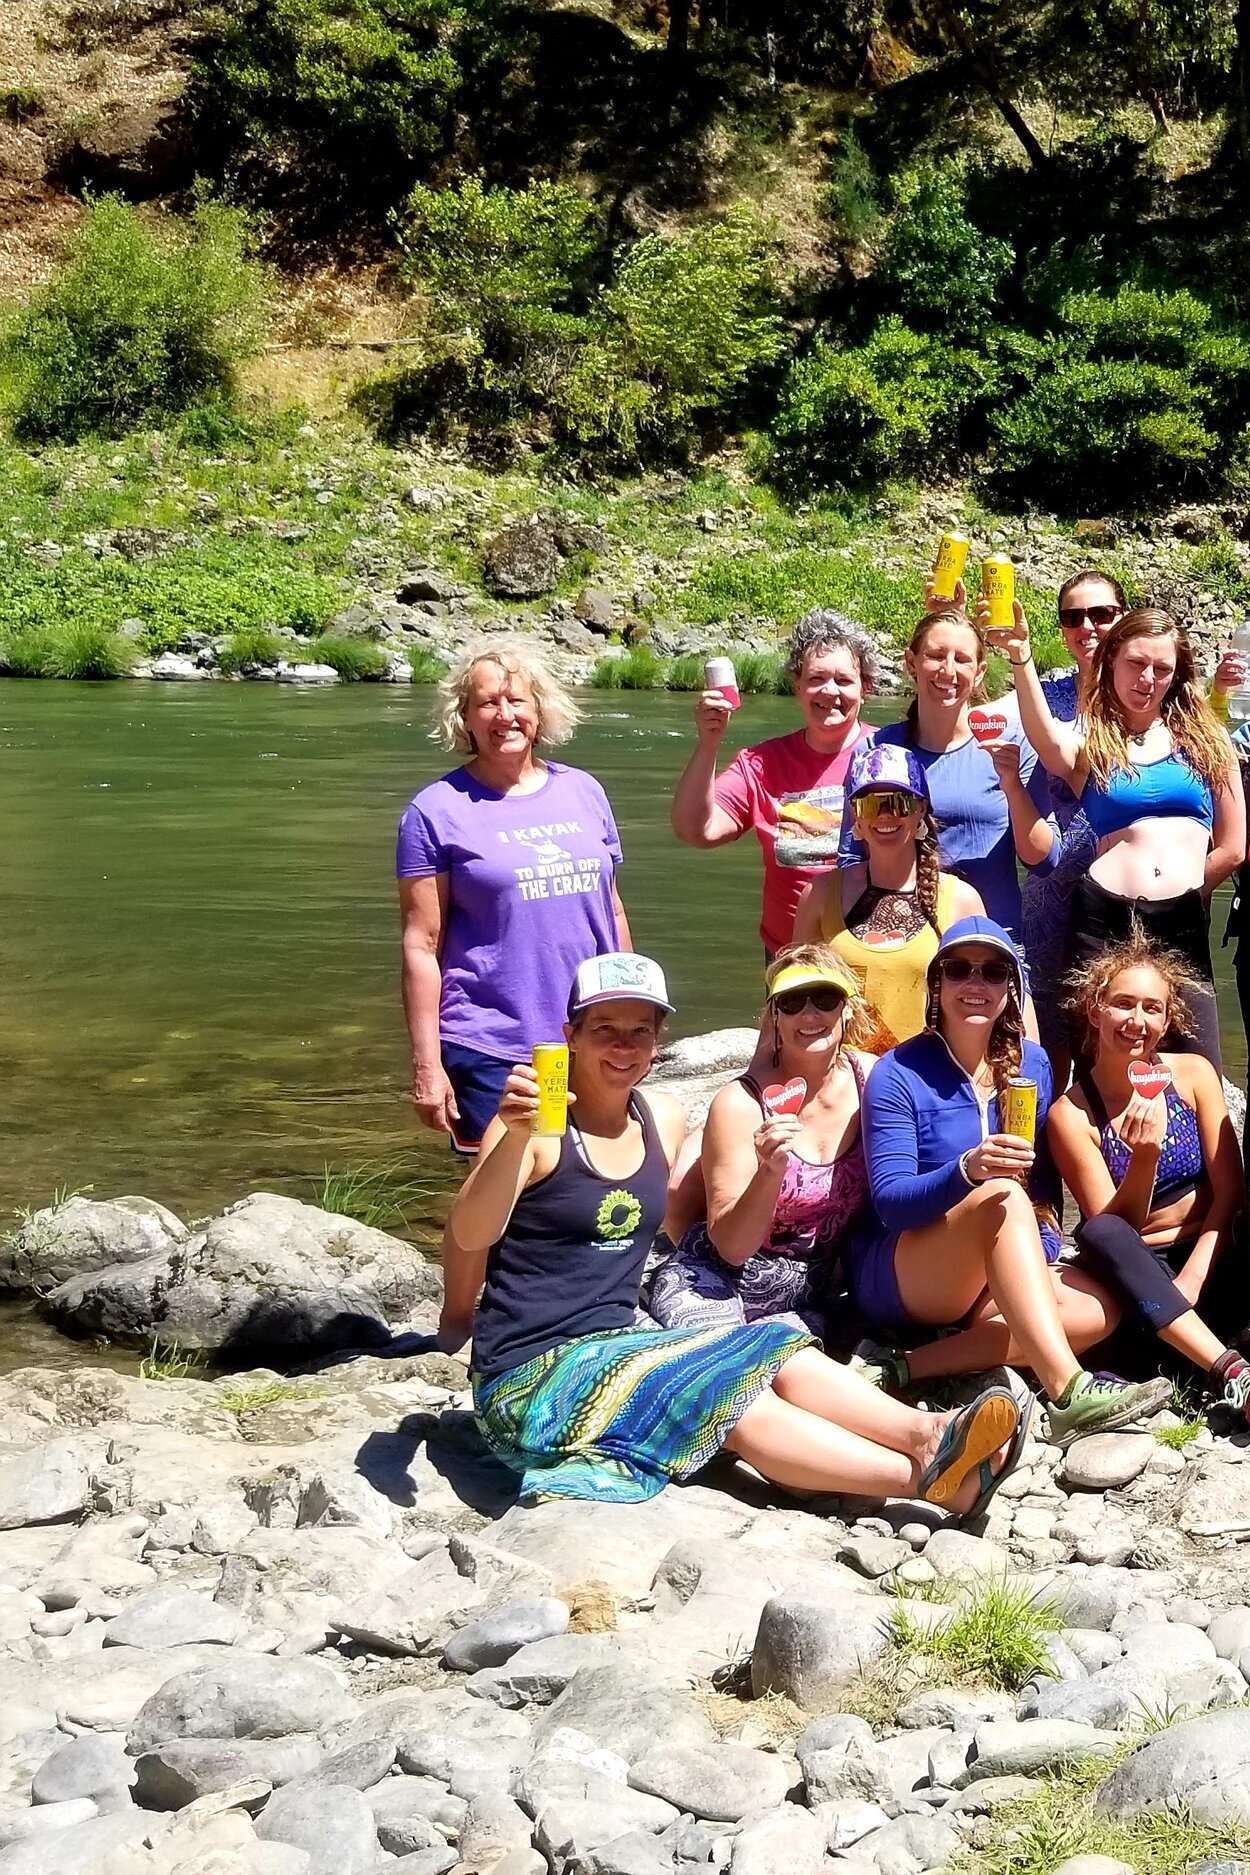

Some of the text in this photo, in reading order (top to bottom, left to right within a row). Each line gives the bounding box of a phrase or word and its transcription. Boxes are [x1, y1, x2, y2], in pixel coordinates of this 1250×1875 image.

[968, 718, 1006, 733] kayaking
[498, 821, 584, 844] I KAYAK
[514, 858, 601, 882] TO BURN OFF
[518, 872, 601, 901] THE CRAZY
